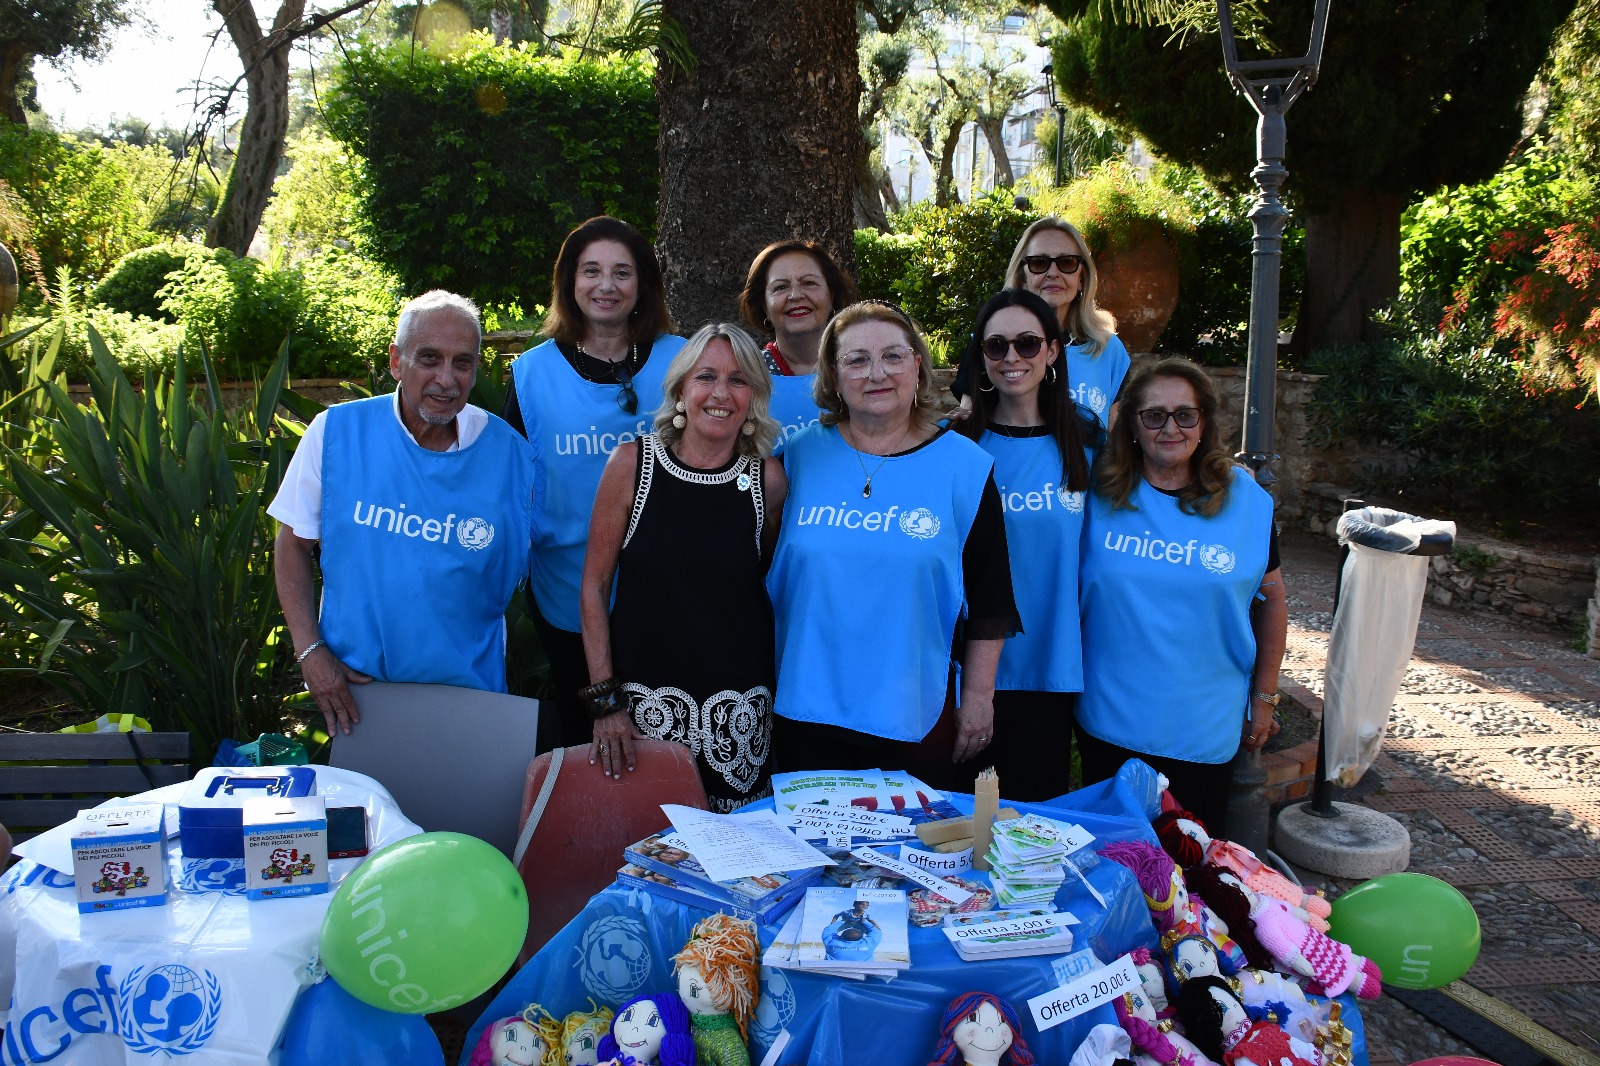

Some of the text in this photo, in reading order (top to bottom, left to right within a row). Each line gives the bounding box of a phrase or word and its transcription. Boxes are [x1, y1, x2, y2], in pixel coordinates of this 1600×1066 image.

[1001, 482, 1054, 512] icef
[353, 500, 456, 544] unicef
[798, 500, 899, 533] unicef
[1104, 529, 1198, 566] unicef
[86, 809, 151, 821] OFFERTE
[801, 807, 845, 817] Offerta
[837, 823, 882, 836] Offerta
[862, 852, 905, 871] Offerta
[907, 851, 974, 869] Offerta 5,0
[284, 887, 304, 895] unicef
[118, 899, 139, 907] unicef
[956, 925, 1007, 938] Offerta
[1009, 920, 1041, 932] 3,00
[1045, 918, 1056, 926] €
[1040, 968, 1131, 1020] Offerta 20,00 €
[1, 965, 120, 1066] icef
